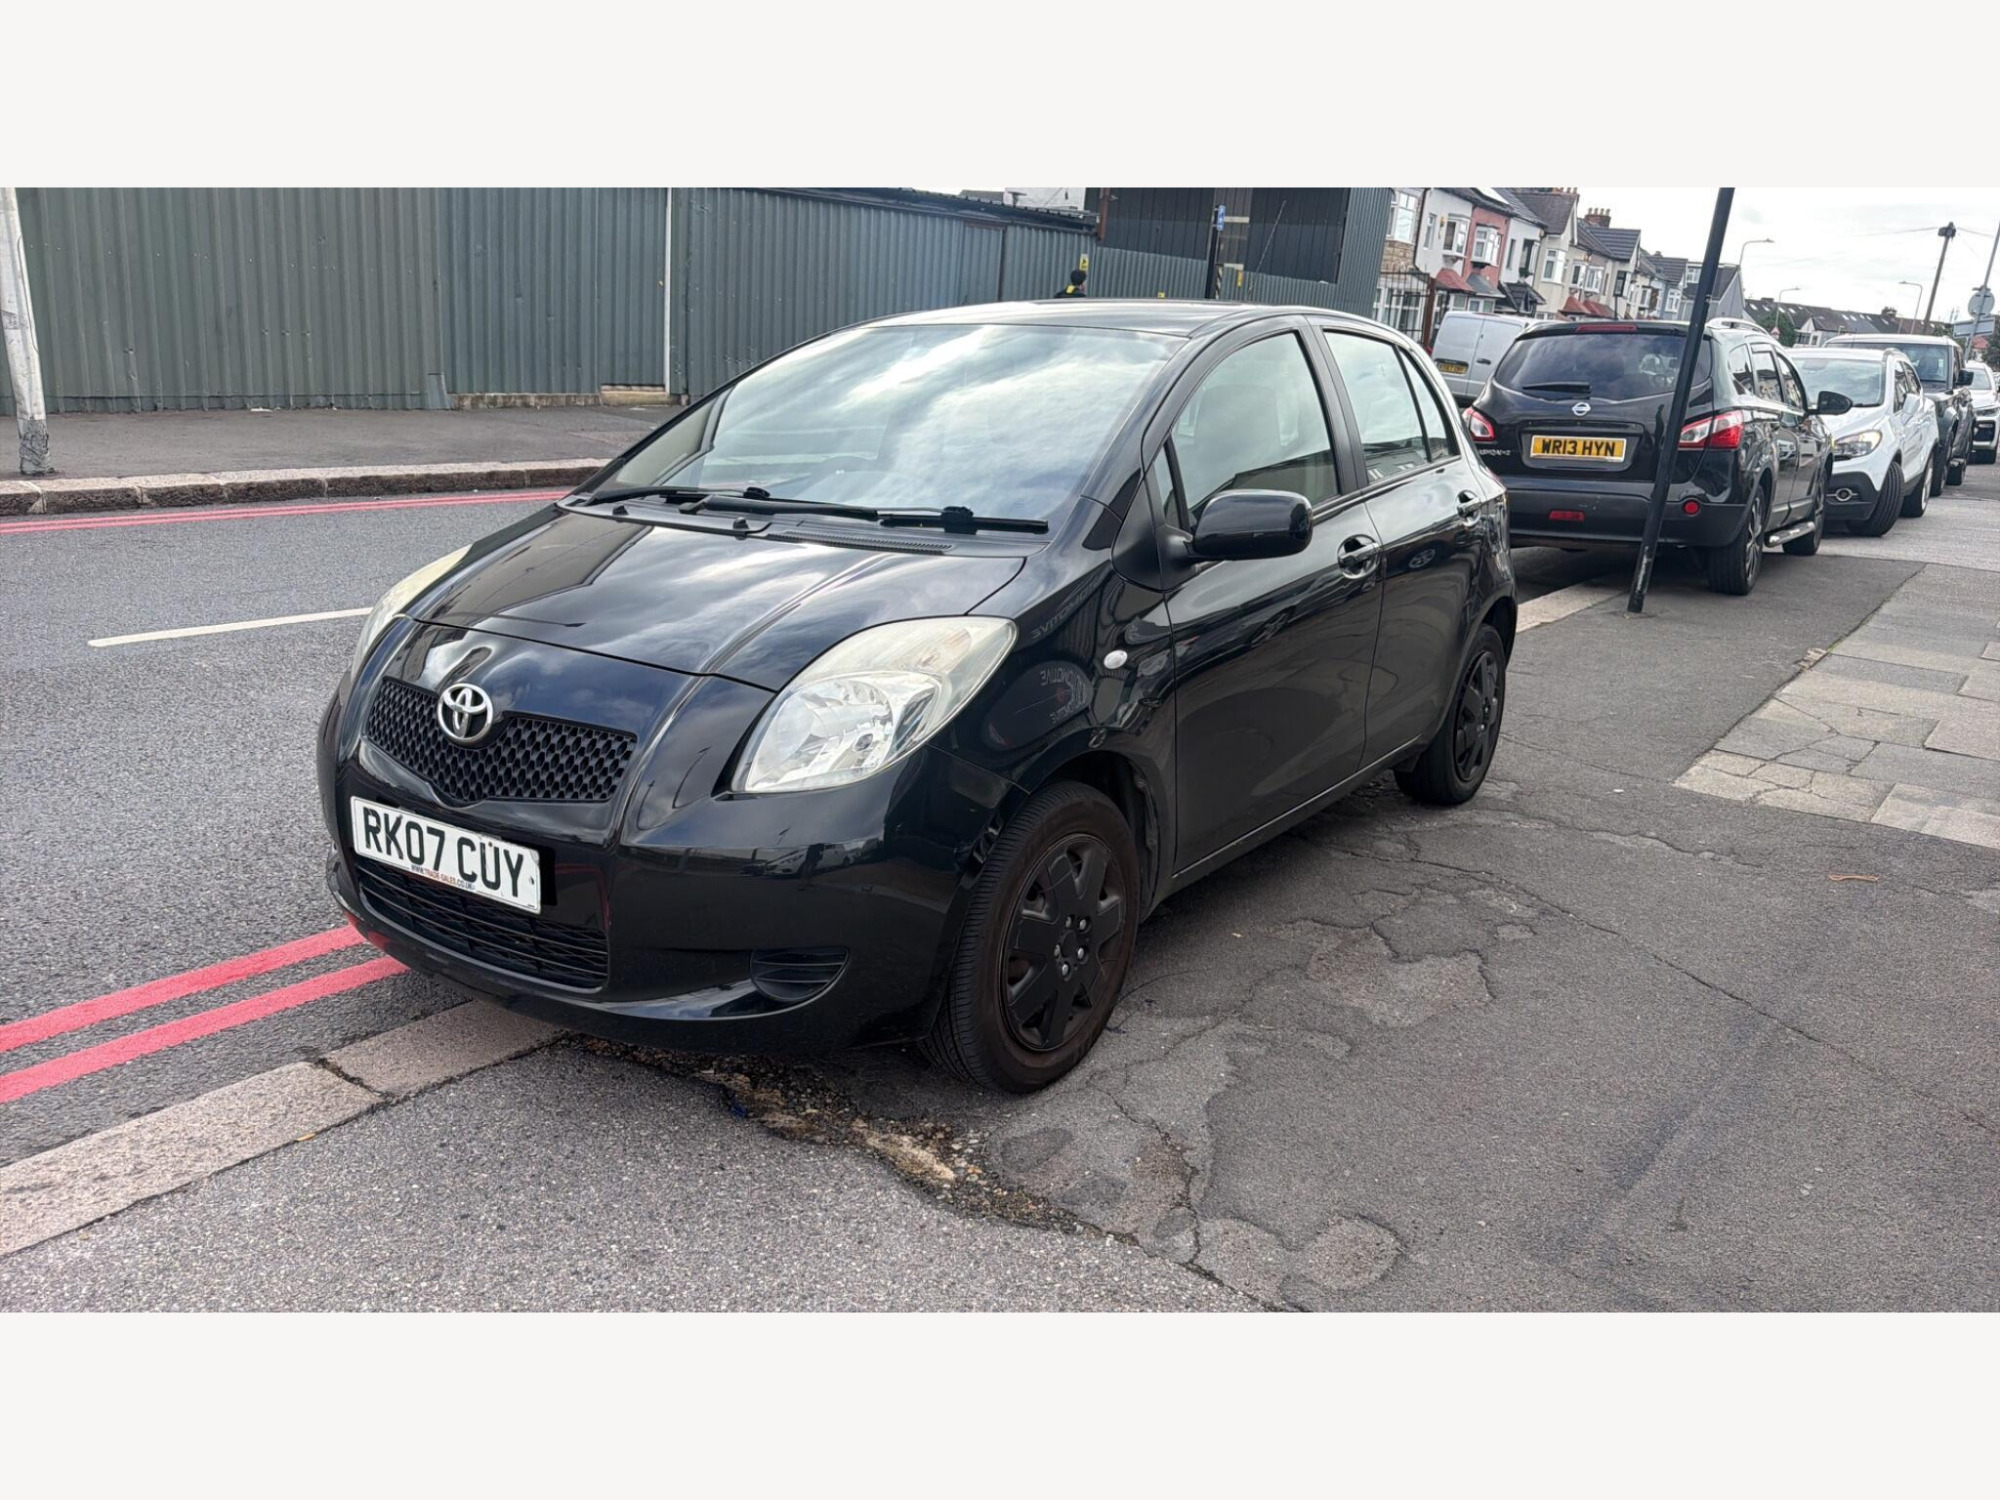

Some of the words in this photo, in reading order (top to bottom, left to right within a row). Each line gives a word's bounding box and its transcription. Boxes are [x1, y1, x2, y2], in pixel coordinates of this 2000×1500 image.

[1541, 438, 1578, 456] WR13
[1582, 440, 1616, 457] HYN
[363, 806, 446, 871] RK07
[457, 836, 524, 898] CUY
